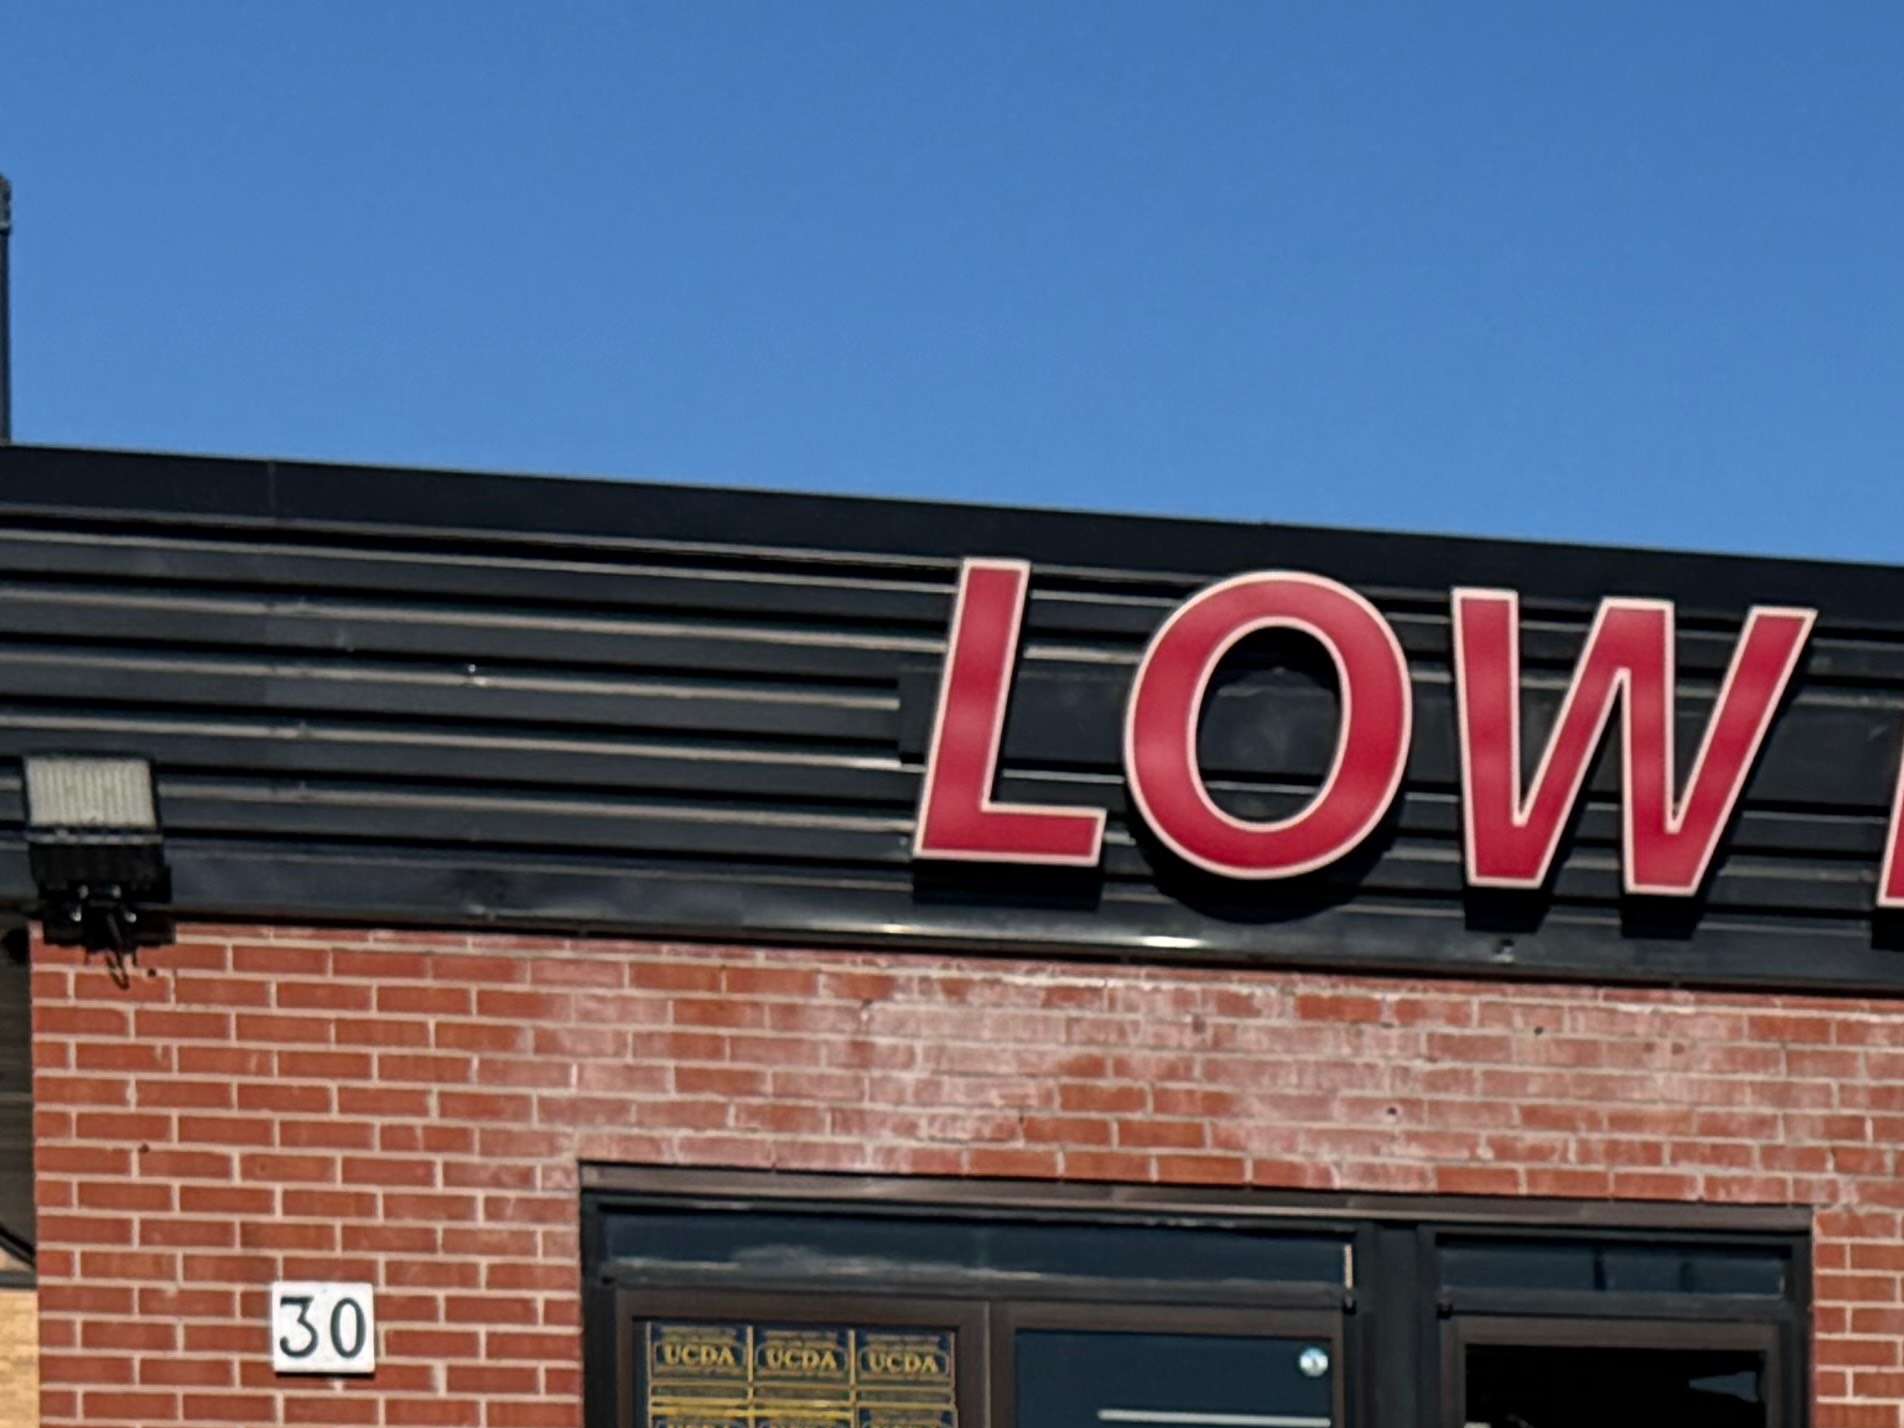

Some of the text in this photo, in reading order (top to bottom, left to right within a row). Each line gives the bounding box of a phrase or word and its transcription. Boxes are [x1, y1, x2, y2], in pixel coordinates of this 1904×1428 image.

[912, 556, 1819, 897] LOW
[279, 1296, 367, 1360] 30
[664, 1343, 737, 1367] UCDA
[766, 1349, 838, 1370] UCDA
[868, 1351, 939, 1374] UCDA
